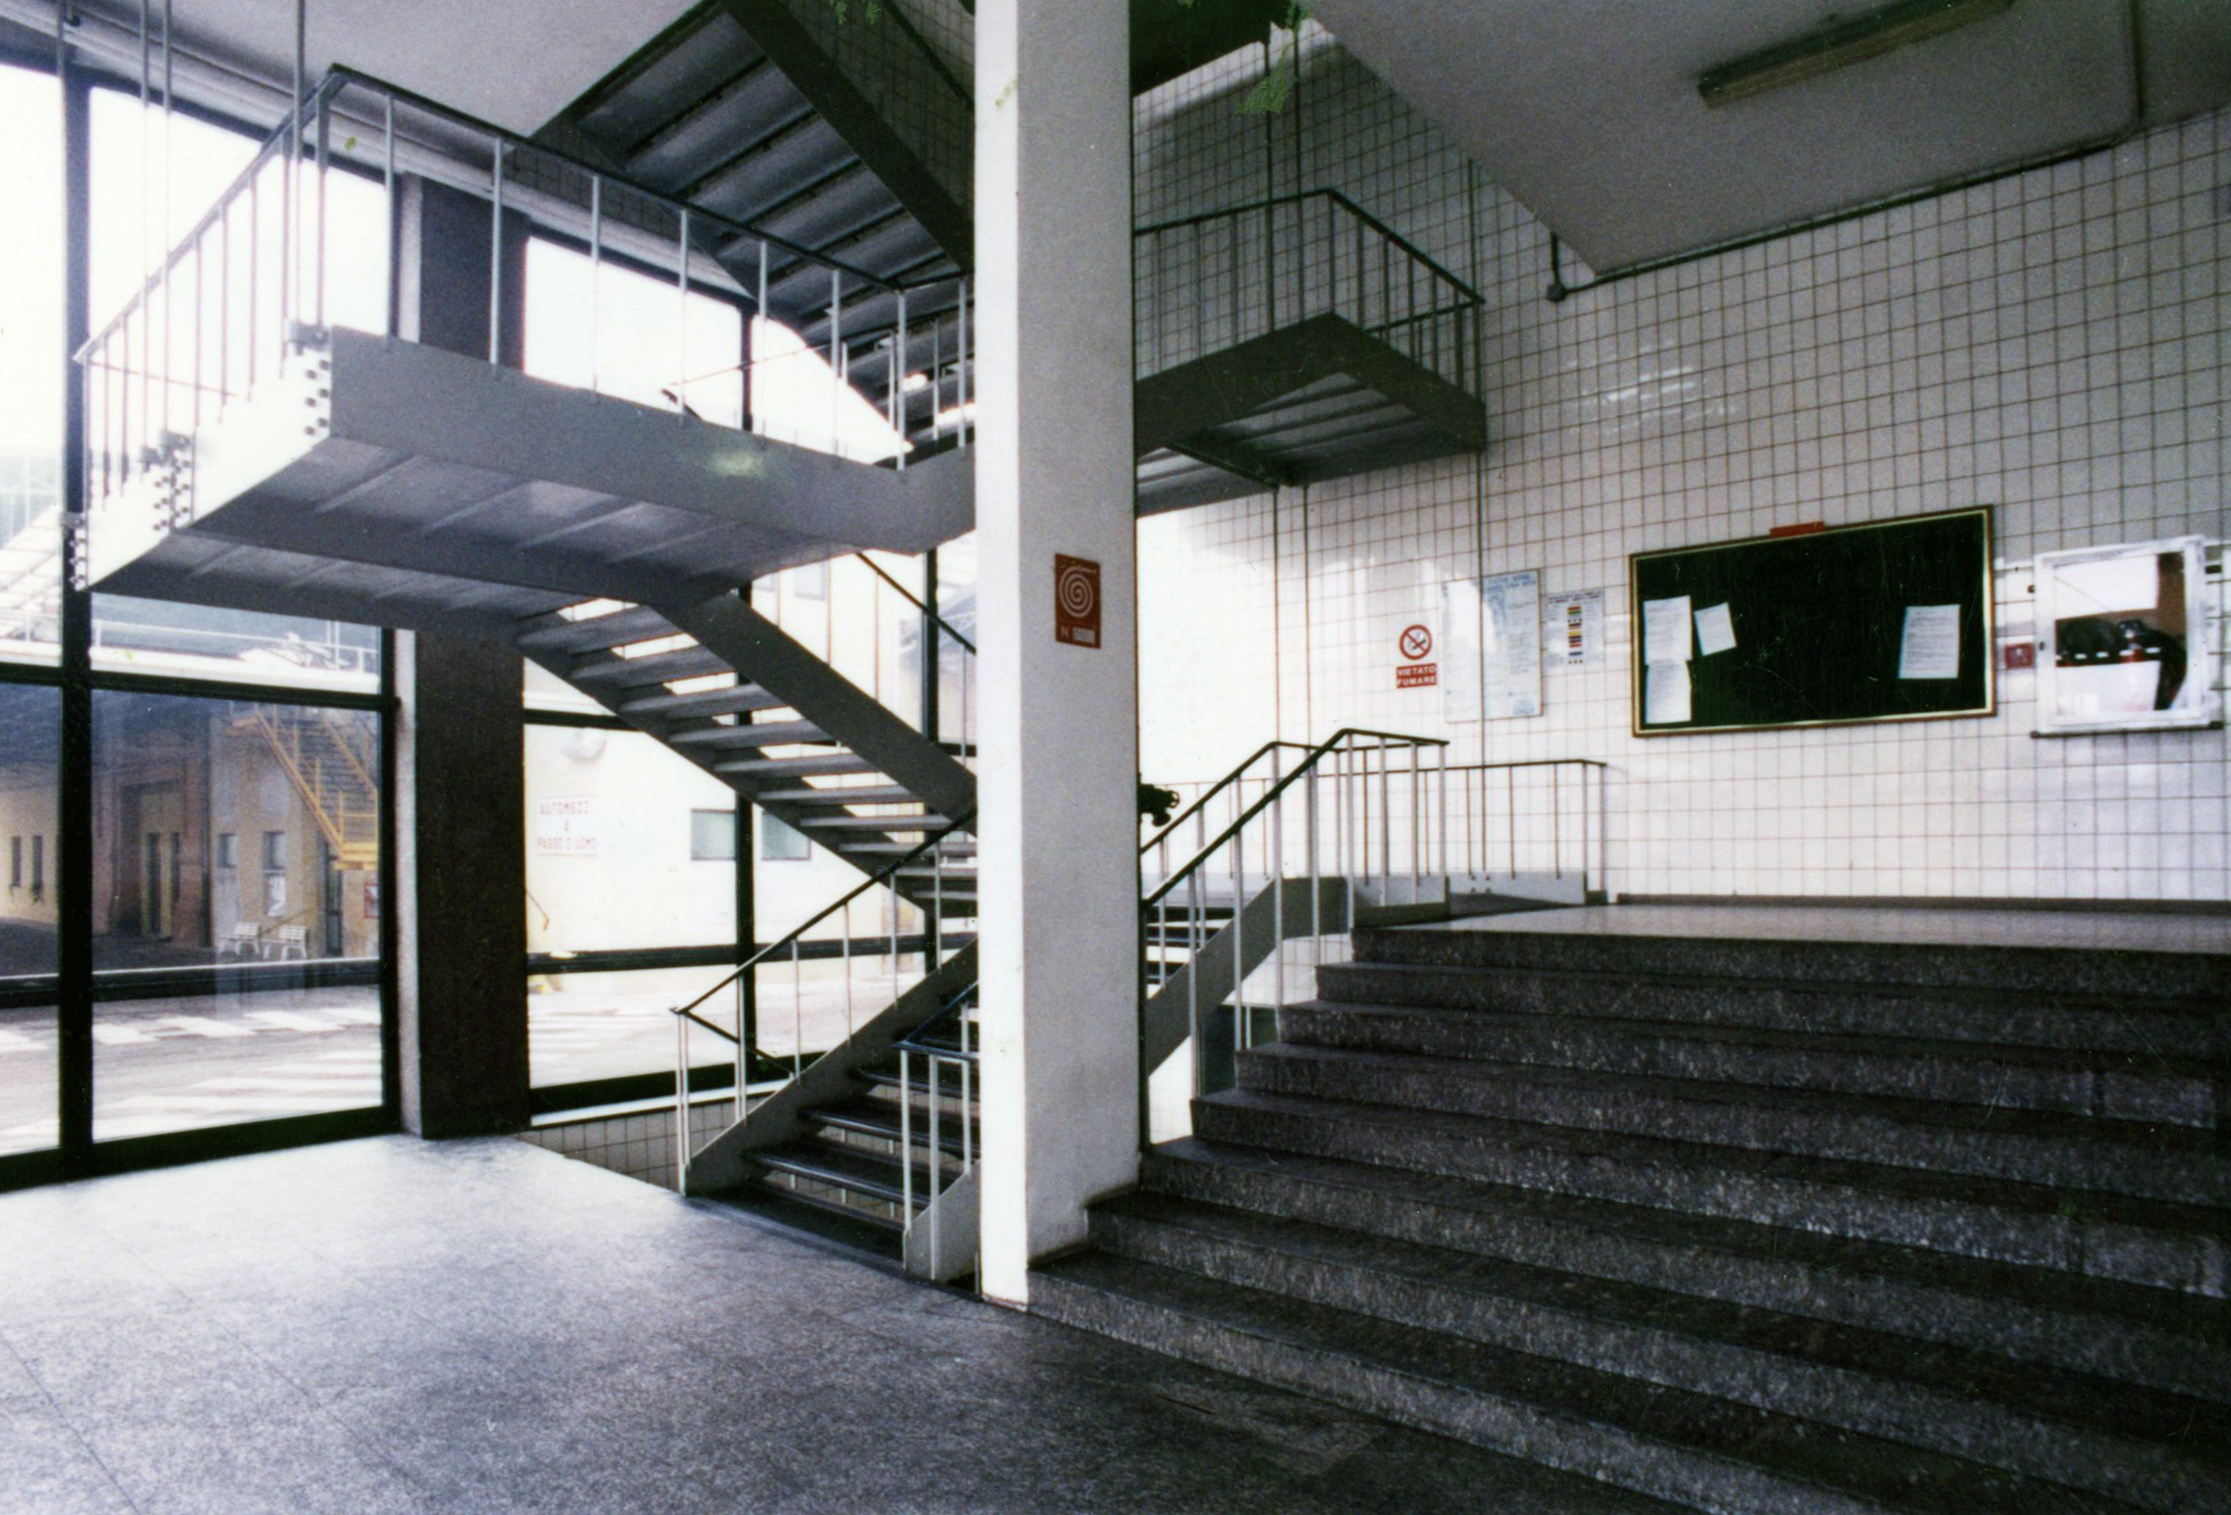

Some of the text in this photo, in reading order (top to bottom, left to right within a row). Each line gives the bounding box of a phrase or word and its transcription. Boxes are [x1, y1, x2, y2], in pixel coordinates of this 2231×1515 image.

[1397, 666, 1436, 676] VIETATO
[1397, 676, 1436, 686] FUMARE
[540, 802, 592, 816] AUTOMEZZ
